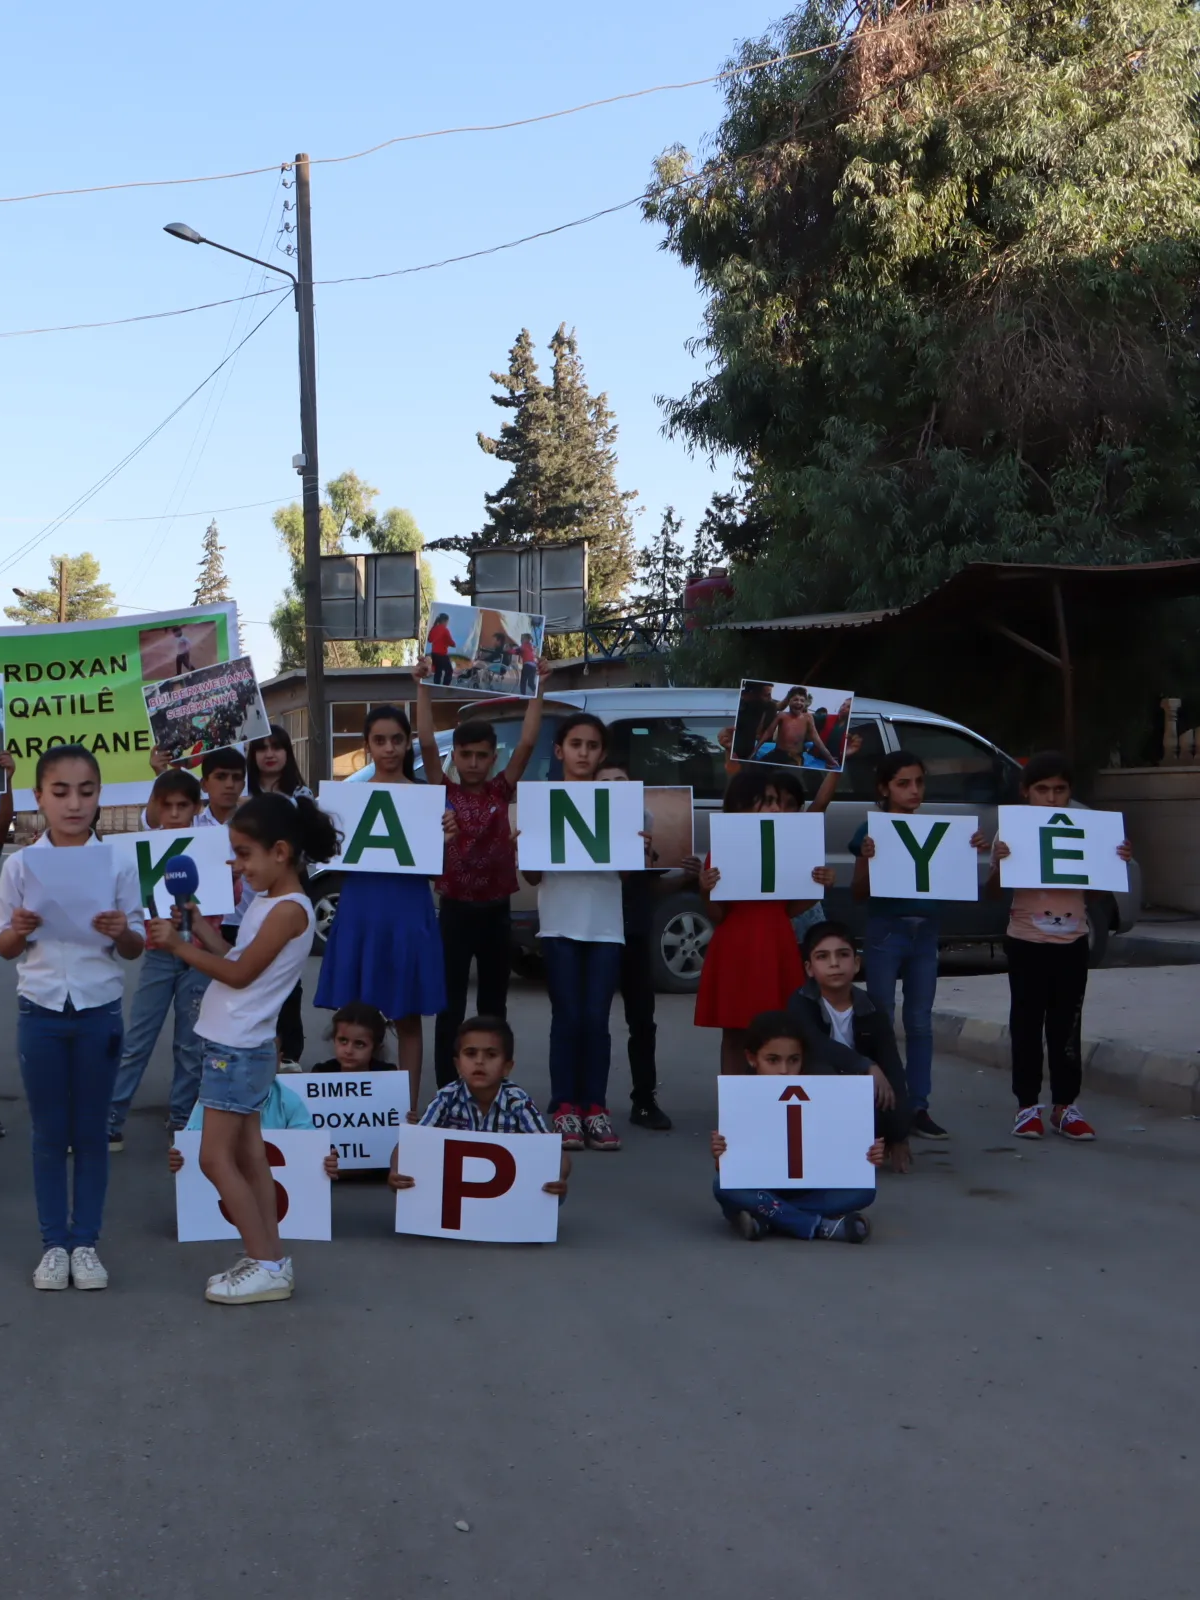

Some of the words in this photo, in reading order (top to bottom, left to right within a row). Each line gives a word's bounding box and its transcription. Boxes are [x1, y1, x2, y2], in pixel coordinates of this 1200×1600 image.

[9, 687, 115, 718] QATILÊ
[171, 670, 252, 701] BERXWEDANA
[343, 790, 415, 866] A
[550, 789, 610, 864] N
[760, 819, 775, 893] I
[891, 820, 951, 892] Y
[1039, 813, 1089, 885] Ê
[136, 837, 201, 908] K
[306, 1081, 373, 1098] BIMRE
[779, 1085, 811, 1179] Î
[441, 1139, 517, 1231] P
